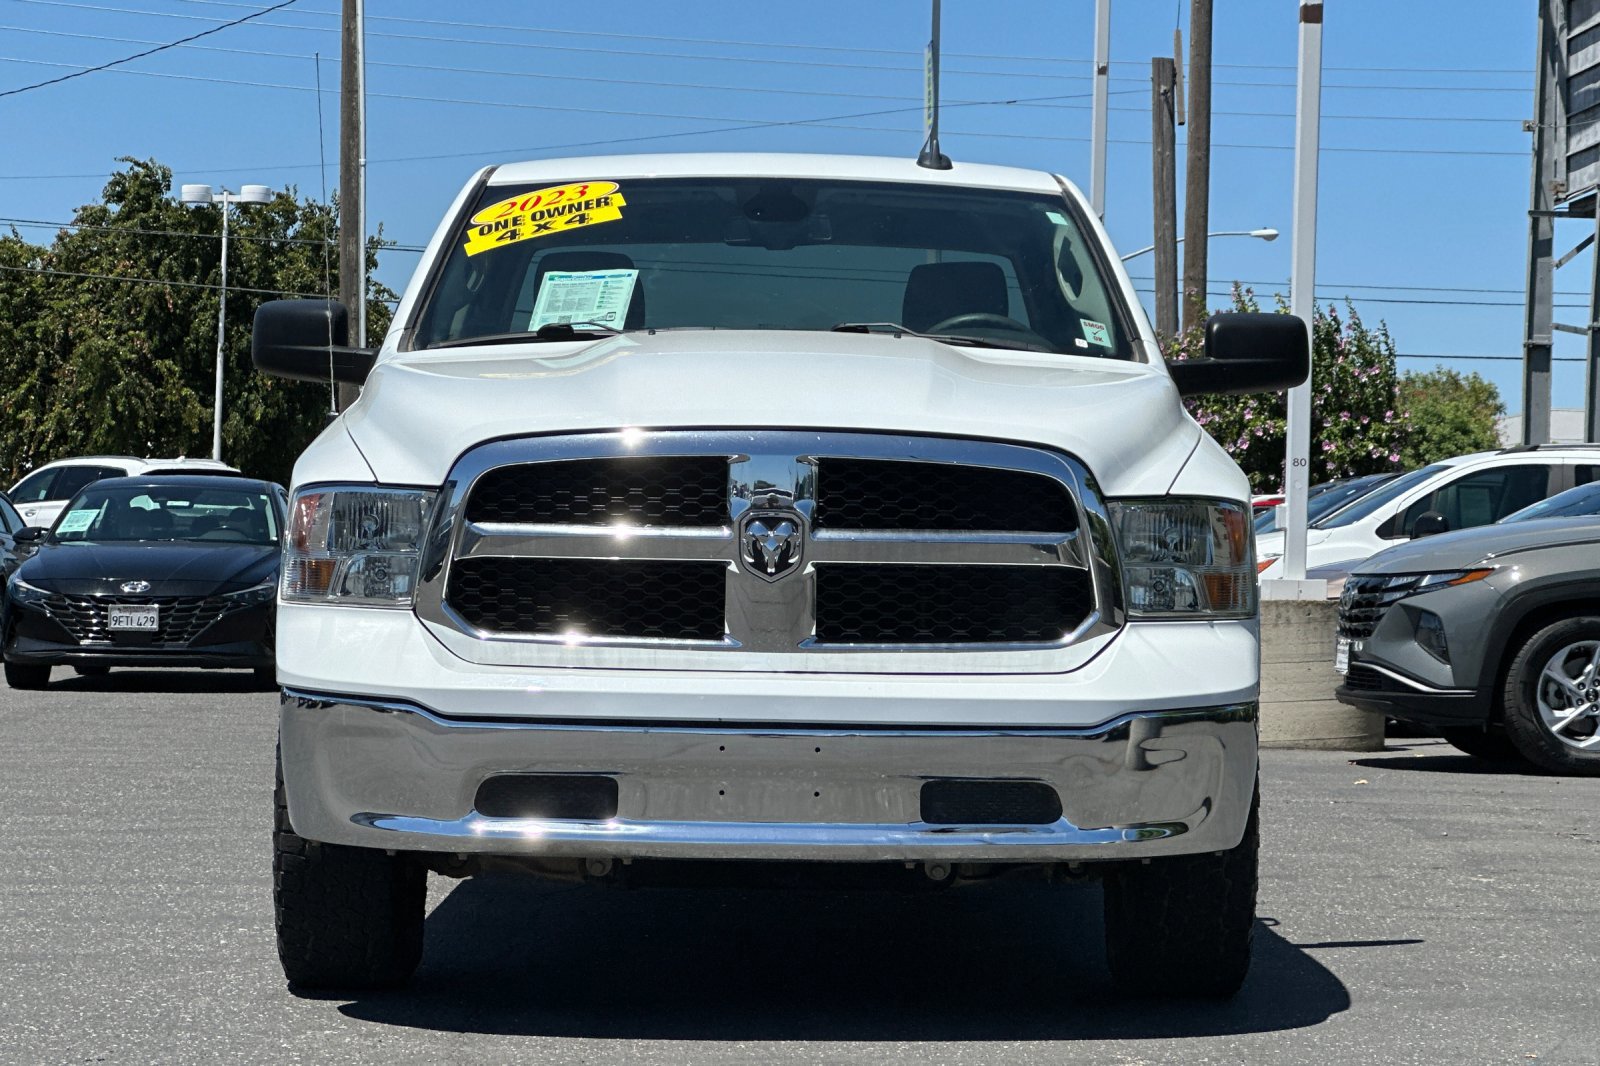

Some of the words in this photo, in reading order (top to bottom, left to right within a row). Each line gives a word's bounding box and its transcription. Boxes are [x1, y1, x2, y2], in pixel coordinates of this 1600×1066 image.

[495, 184, 590, 218] 2023
[478, 214, 526, 237] ONE
[530, 196, 612, 222] OWNER
[495, 227, 524, 242] 4
[563, 212, 593, 226] 4
[1083, 321, 1105, 331] SMOG
[1292, 457, 1307, 467] 80
